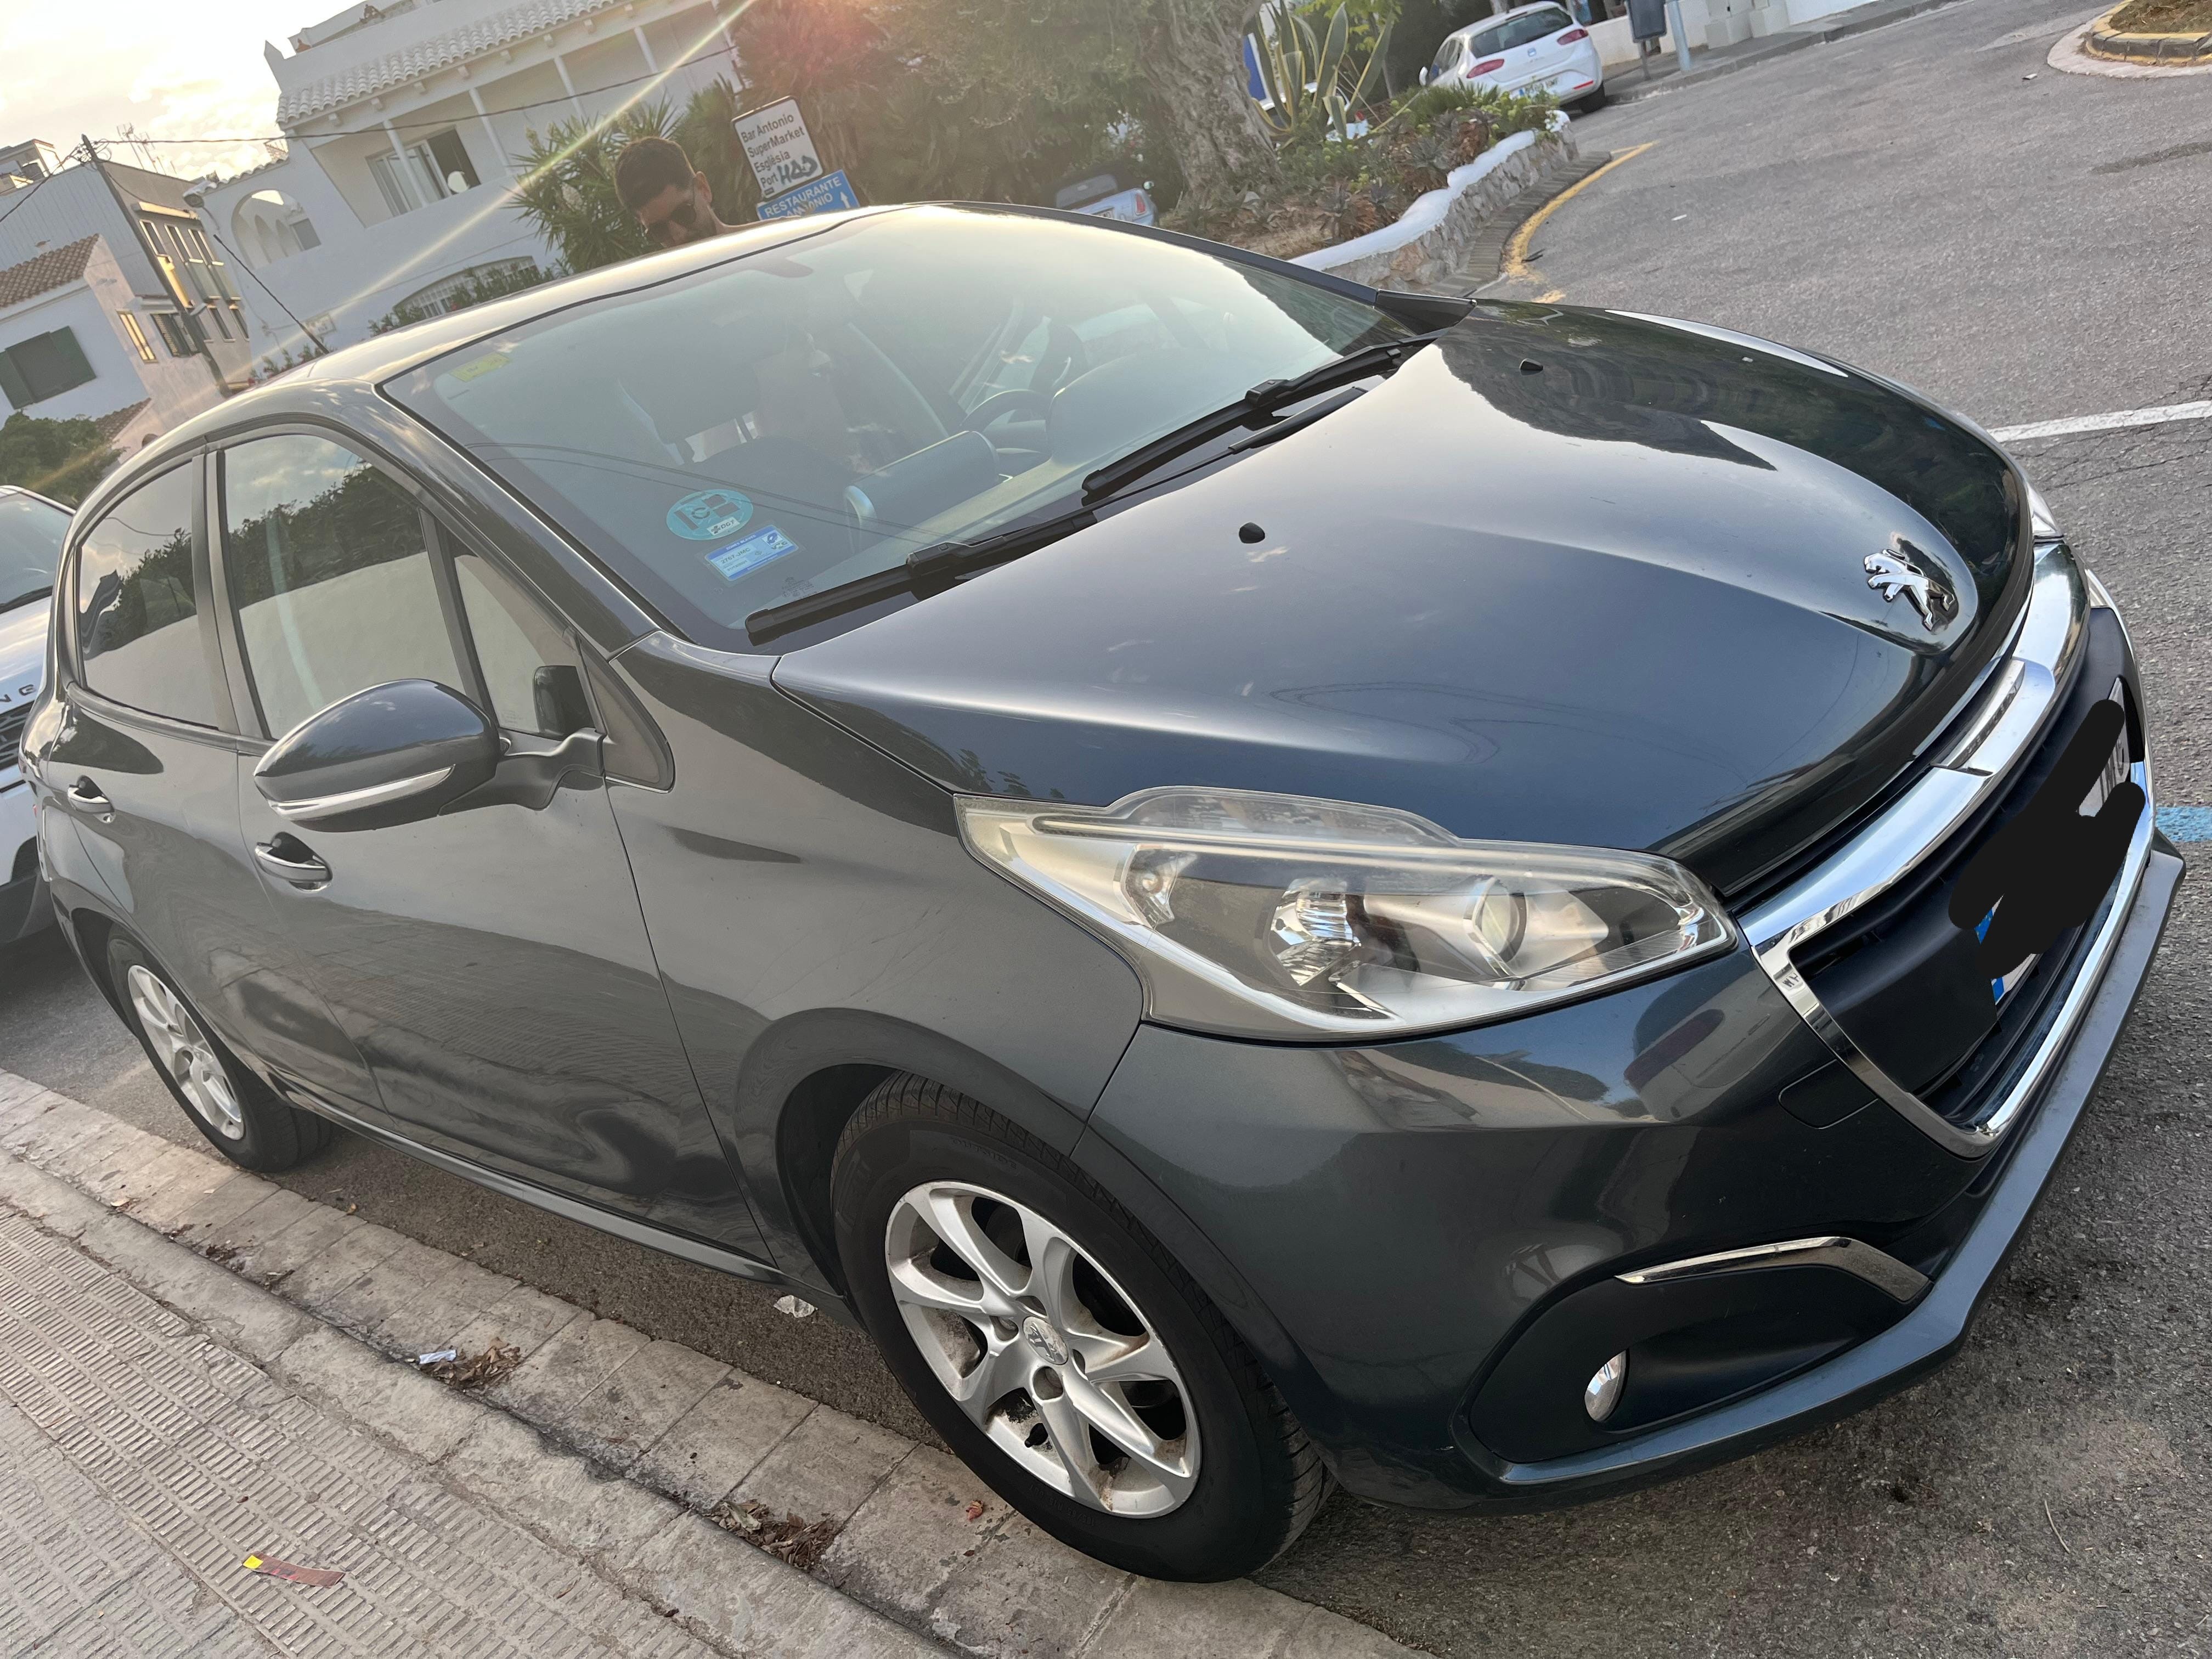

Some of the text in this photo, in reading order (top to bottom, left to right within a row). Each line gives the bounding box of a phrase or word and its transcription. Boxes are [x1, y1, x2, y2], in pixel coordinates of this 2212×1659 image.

[741, 114, 794, 143] Bar Antonio
[747, 126, 805, 158] SuperMarket
[760, 172, 778, 188] Port
[764, 176, 842, 217] RESTAURANTE
